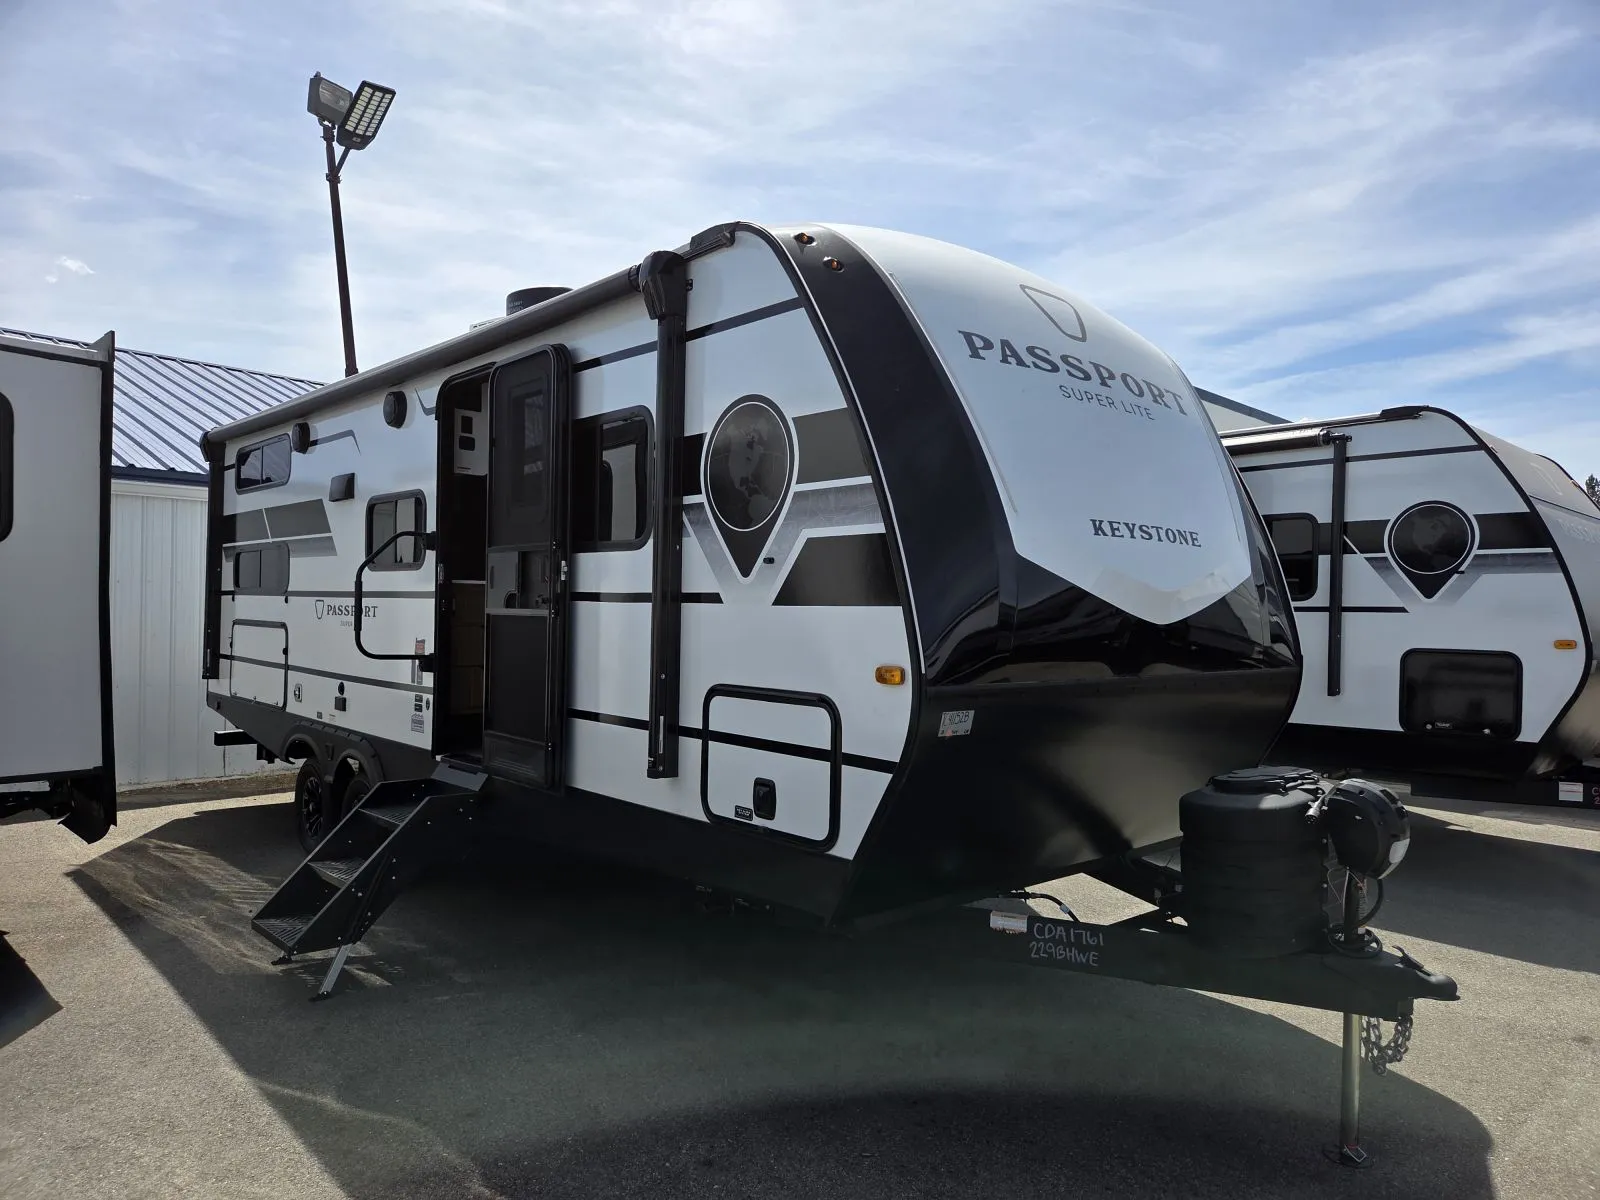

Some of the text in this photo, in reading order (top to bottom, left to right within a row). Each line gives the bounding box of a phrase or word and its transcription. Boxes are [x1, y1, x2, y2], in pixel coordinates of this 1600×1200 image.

[957, 329, 1188, 416] PASSPORT
[1059, 384, 1155, 421] SUPER LITE
[1089, 518, 1202, 548] KEYSTONE
[327, 604, 378, 618] PASSPRT
[1033, 922, 1104, 946] CDA1761
[1029, 941, 1099, 967] 229BHWE
